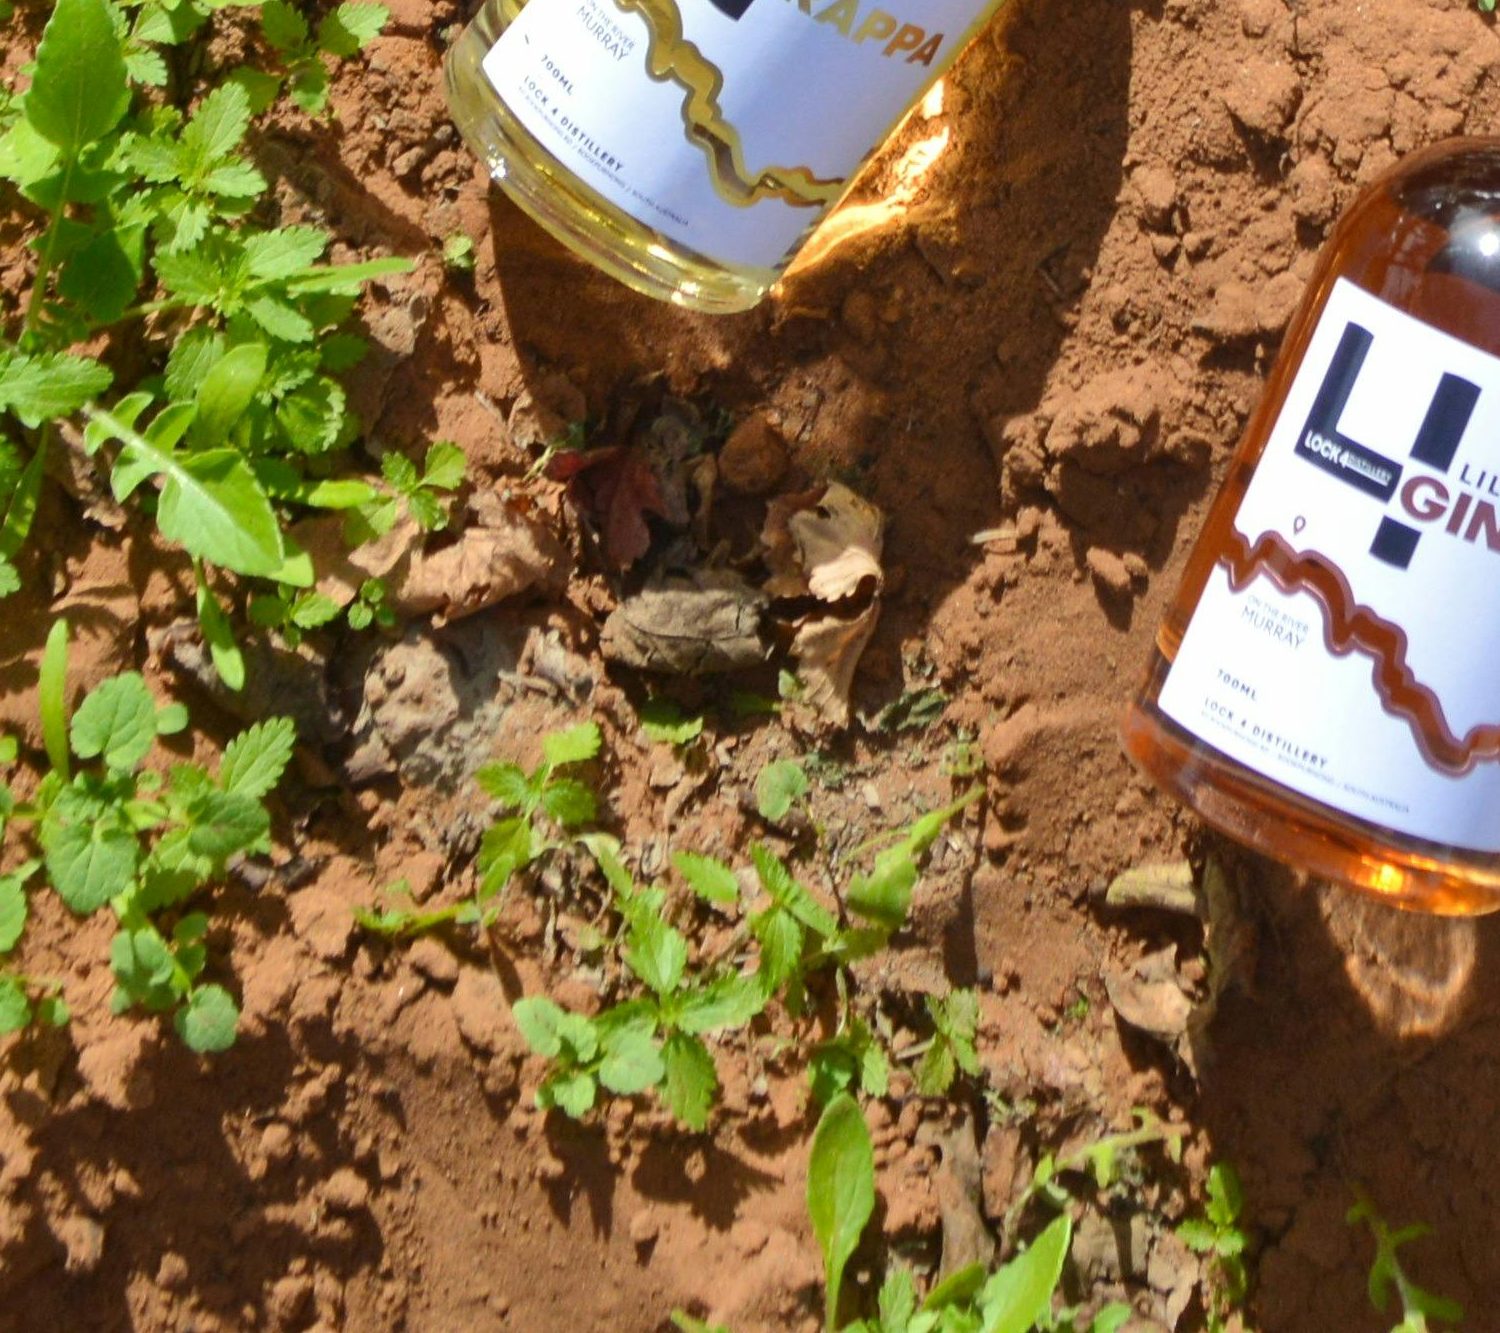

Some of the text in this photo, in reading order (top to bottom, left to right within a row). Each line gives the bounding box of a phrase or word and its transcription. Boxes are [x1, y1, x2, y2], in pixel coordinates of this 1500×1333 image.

[574, 5, 630, 64] MURRAY
[538, 53, 577, 96] 700ML
[522, 75, 551, 108] LOCK
[549, 105, 560, 117] 4
[558, 114, 624, 173] DISTILLERY
[1239, 605, 1305, 651] MURRAY
[1214, 668, 1260, 701] 700ML
[1203, 697, 1329, 770] LOCK 4 DISTILLERY
